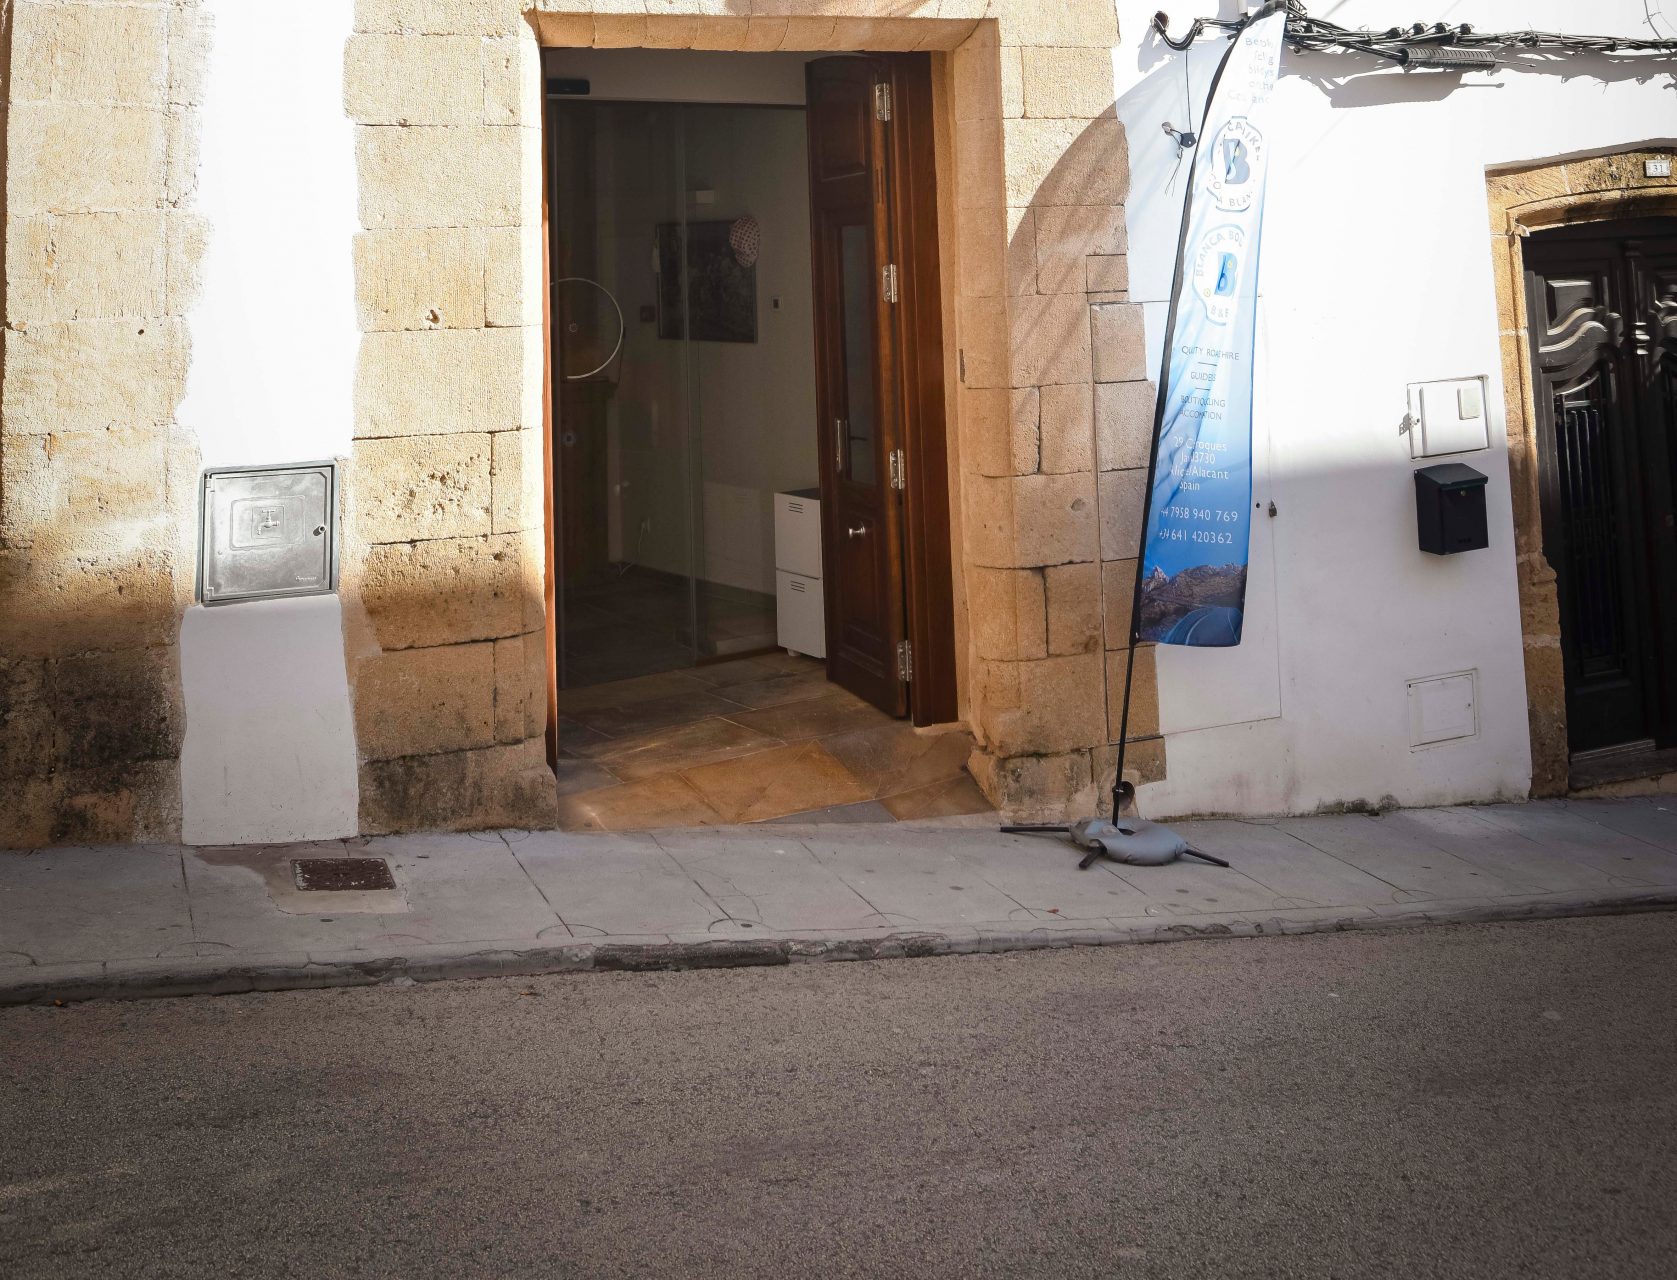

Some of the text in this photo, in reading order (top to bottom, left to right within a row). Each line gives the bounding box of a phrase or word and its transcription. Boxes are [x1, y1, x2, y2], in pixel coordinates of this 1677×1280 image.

[1173, 436, 1184, 448] 29
[1179, 480, 1200, 493] Spain
[1170, 506, 1190, 519] 7958
[1192, 508, 1211, 521] 940
[1215, 510, 1238, 522] 769
[1171, 528, 1188, 541] 641
[1191, 530, 1233, 544] 420362
